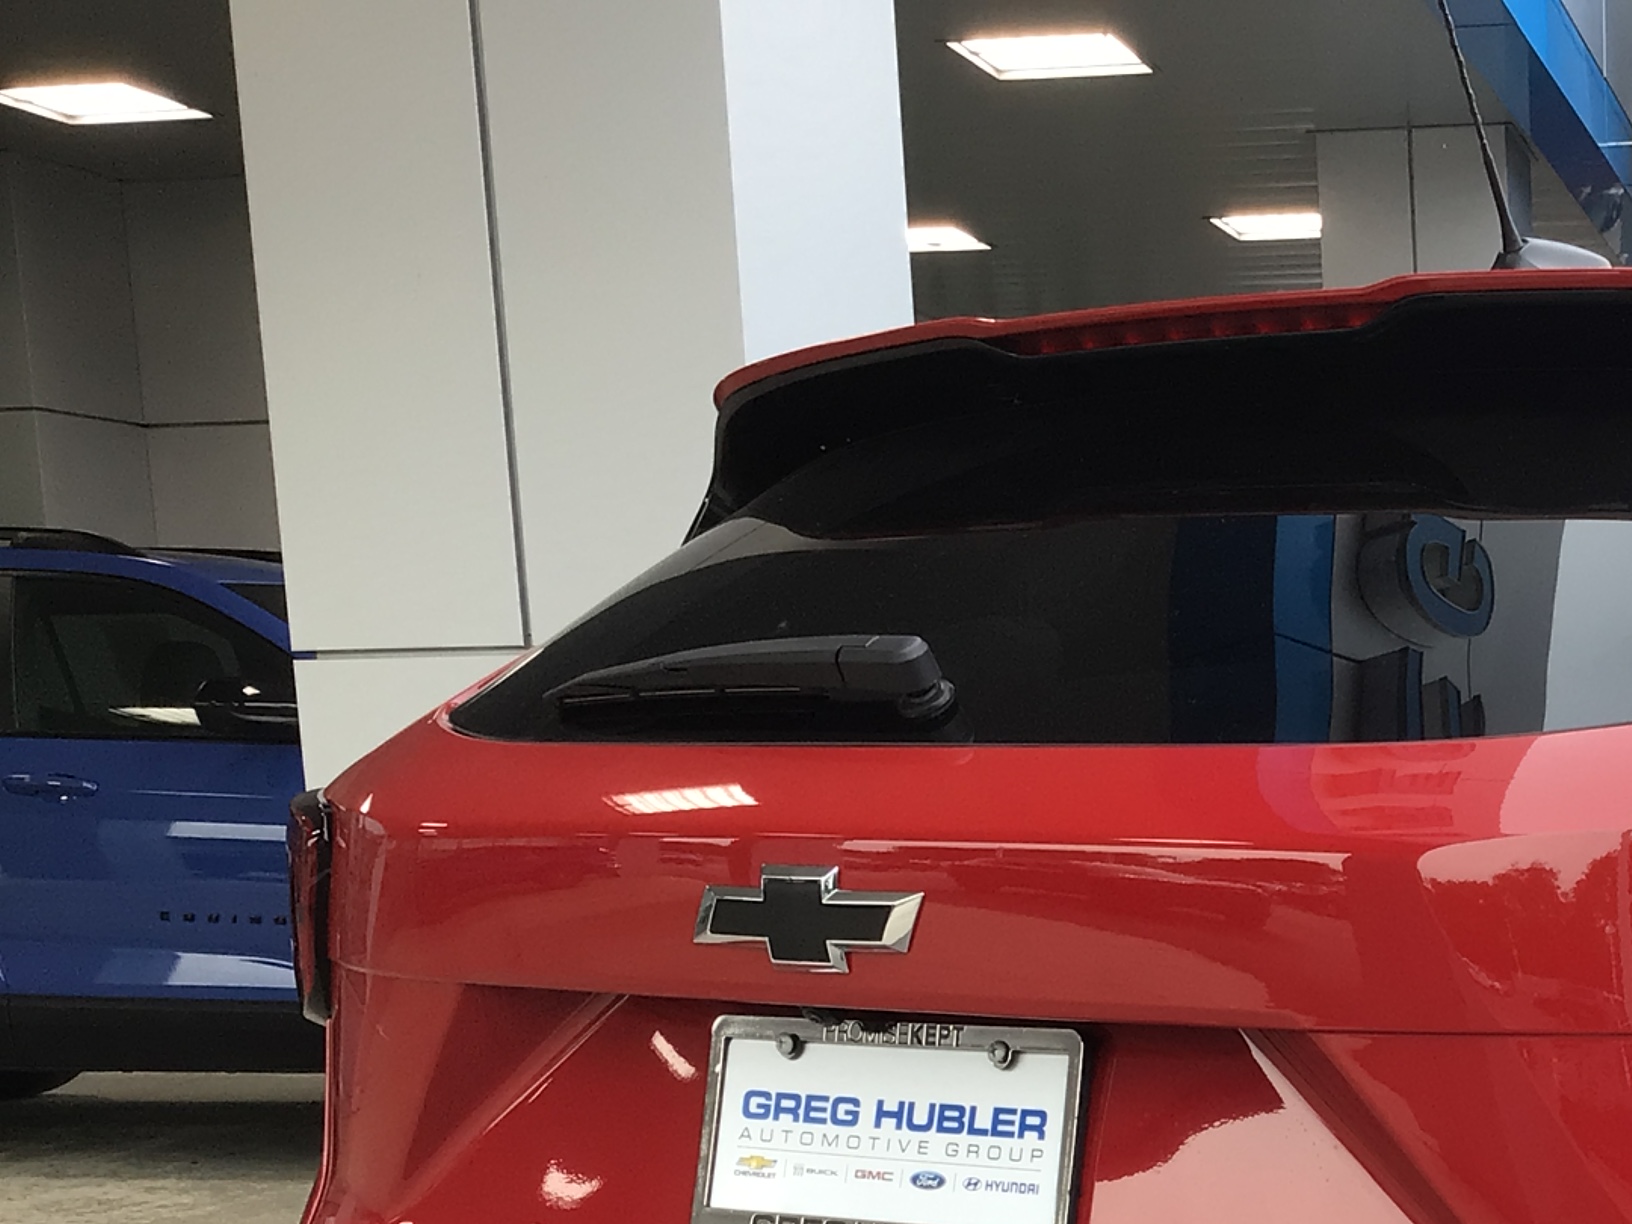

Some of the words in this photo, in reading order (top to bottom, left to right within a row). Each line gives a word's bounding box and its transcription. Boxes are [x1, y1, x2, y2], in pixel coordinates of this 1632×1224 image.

[742, 1089, 861, 1127] GREG
[873, 1099, 1048, 1141] HUBLER
[738, 1126, 930, 1156] AUTOMOTIVE
[945, 1141, 1044, 1163] GROUP
[805, 1167, 838, 1177] BUICK
[854, 1169, 894, 1182] GMC
[985, 1180, 1040, 1196] HYUNDAI
